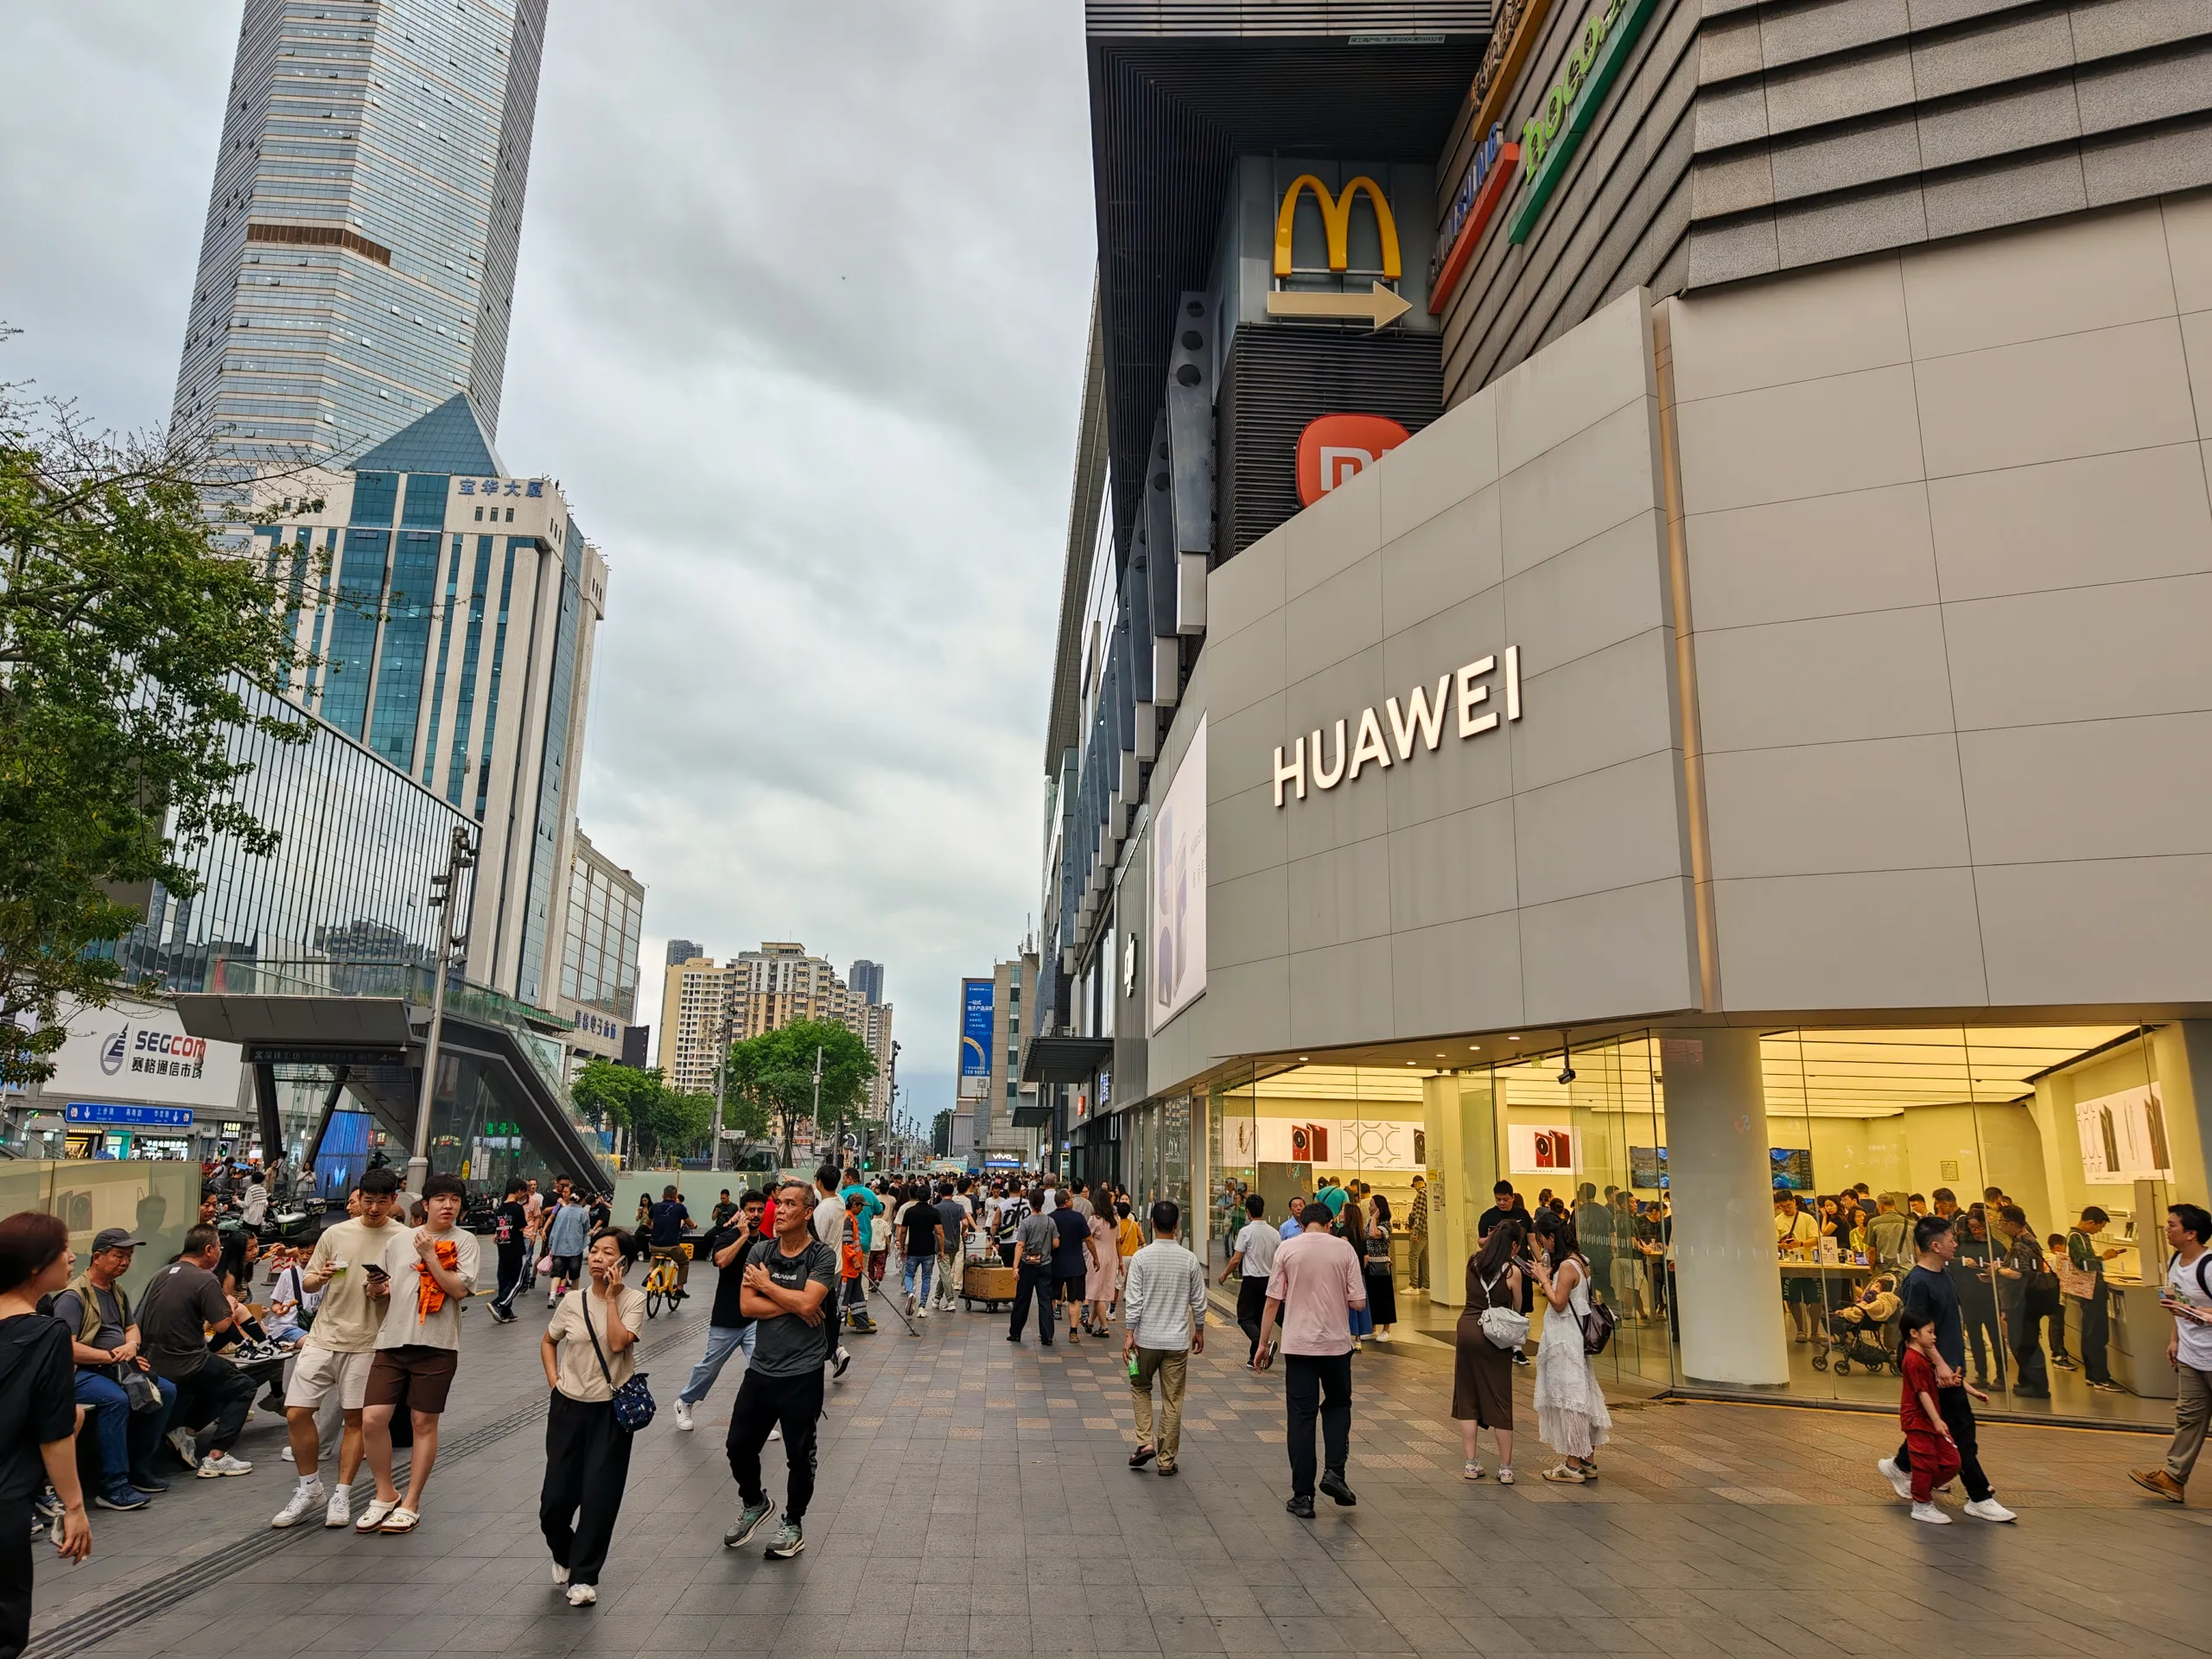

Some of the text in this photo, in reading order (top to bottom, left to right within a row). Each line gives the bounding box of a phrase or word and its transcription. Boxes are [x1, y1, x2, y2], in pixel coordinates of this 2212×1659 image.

[458, 478, 544, 499] 宝华大厦
[1274, 645, 1522, 809] HUAWEI
[135, 1031, 207, 1058] SEGCOM
[131, 1056, 203, 1079] 赛格通信市场
